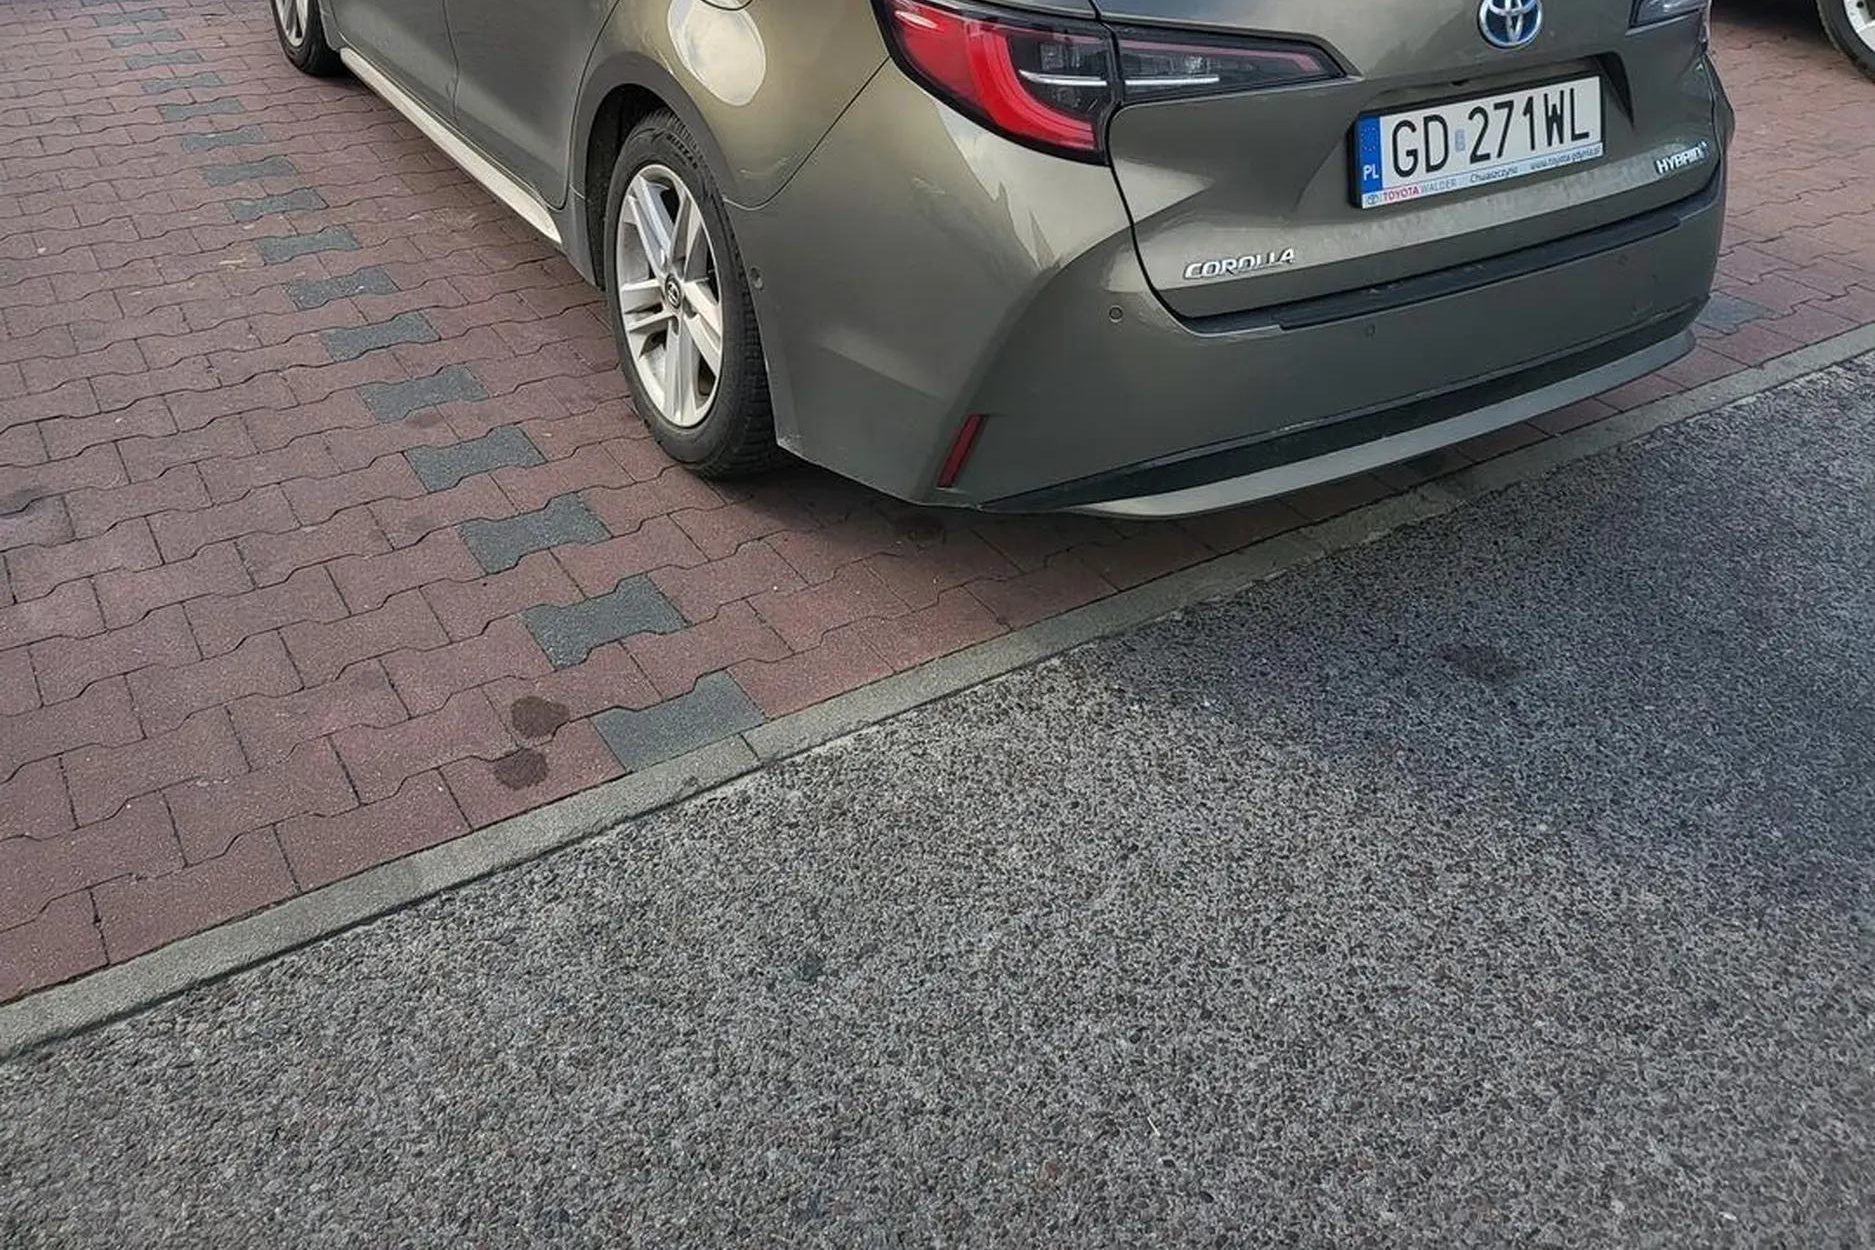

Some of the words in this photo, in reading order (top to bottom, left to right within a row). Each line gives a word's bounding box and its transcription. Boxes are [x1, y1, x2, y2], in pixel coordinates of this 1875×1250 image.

[1391, 114, 1449, 178] GD
[1467, 87, 1590, 165] 271WL
[1363, 163, 1380, 181] PL
[1383, 186, 1420, 201] TOYOTA
[1421, 178, 1457, 194] WALDER
[1184, 248, 1296, 279] COROLLA
